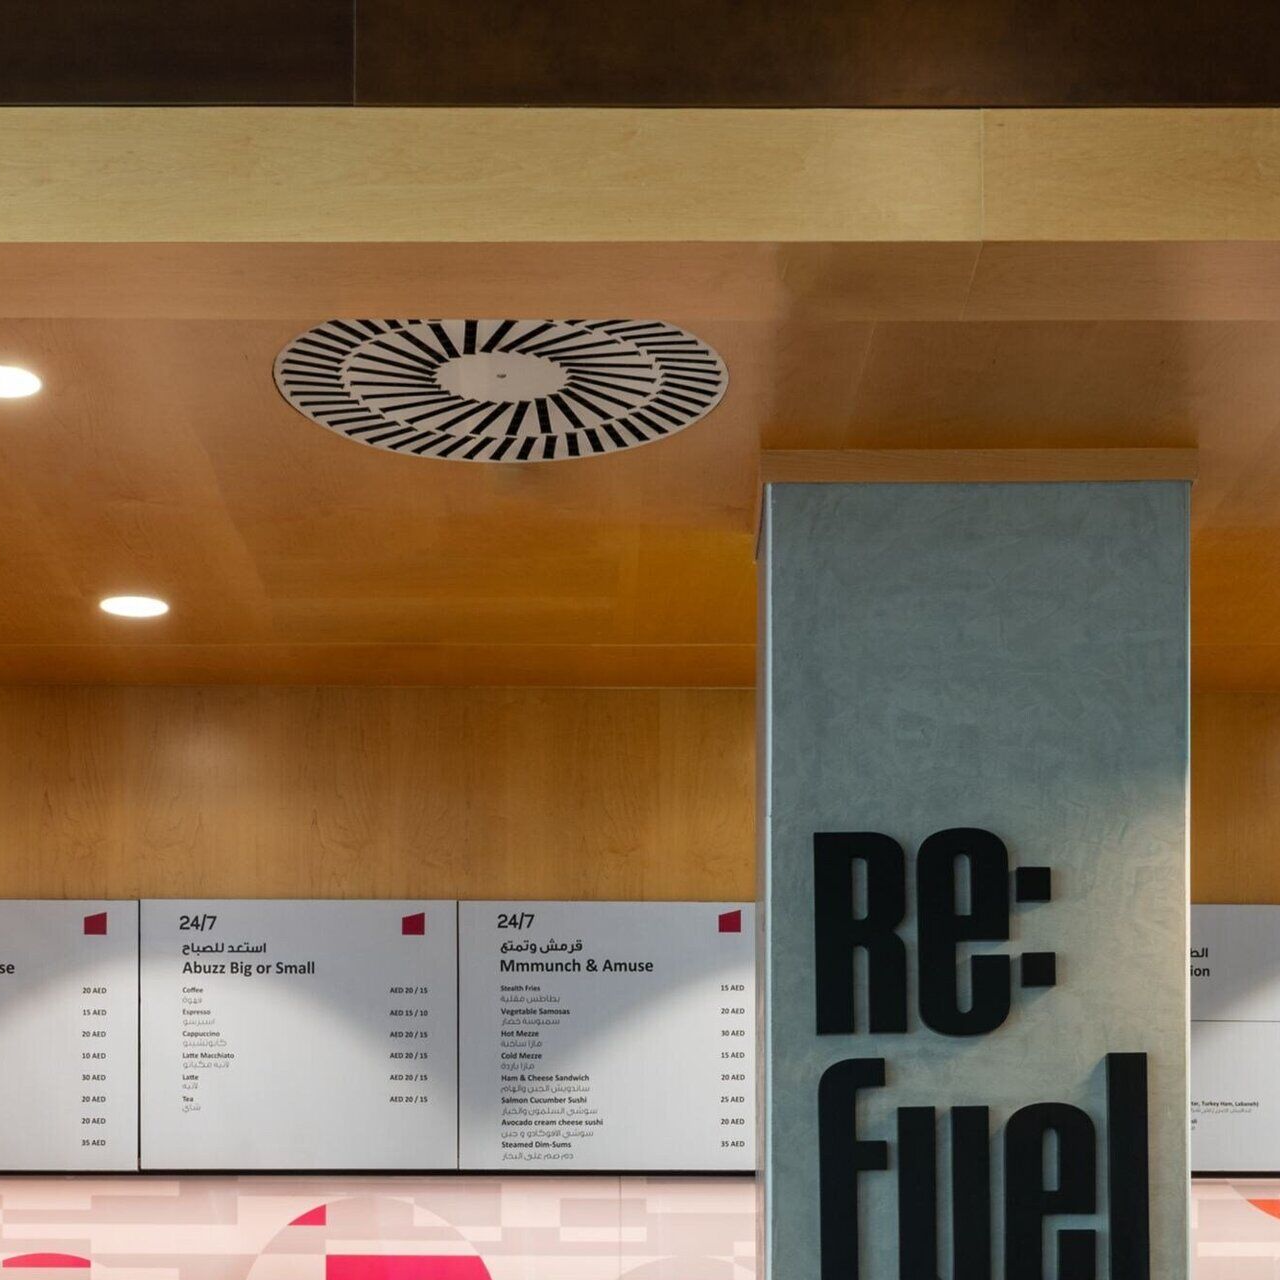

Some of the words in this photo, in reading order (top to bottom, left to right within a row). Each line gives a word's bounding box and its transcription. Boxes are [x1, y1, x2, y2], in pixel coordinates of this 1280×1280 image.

[179, 913, 218, 932] 24/7
[496, 911, 536, 931] 24/7
[181, 942, 225, 956] للصباح
[227, 941, 267, 954] استعد
[500, 940, 537, 954] وتمتع
[538, 938, 583, 954] قرمش
[182, 960, 226, 975] Abuzz
[230, 960, 252, 977] Big
[256, 964, 272, 975] or
[275, 960, 315, 975] Small
[500, 958, 581, 973] Mmmunch
[585, 958, 599, 973] &
[602, 958, 654, 973] Amuse
[182, 986, 204, 994] Coffee
[720, 984, 730, 992] 15
[730, 984, 746, 992] AED
[182, 1008, 212, 1017] Espresso
[720, 1007, 730, 1015] 20
[730, 1007, 746, 1015] AED
[182, 1029, 222, 1038] Cappuccino
[720, 1029, 730, 1037] 30
[730, 1029, 746, 1037] AED
[182, 1051, 200, 1060] Latte
[200, 1051, 234, 1060] Macchiato
[182, 1073, 200, 1081] Latte
[182, 1095, 194, 1103] Tea
